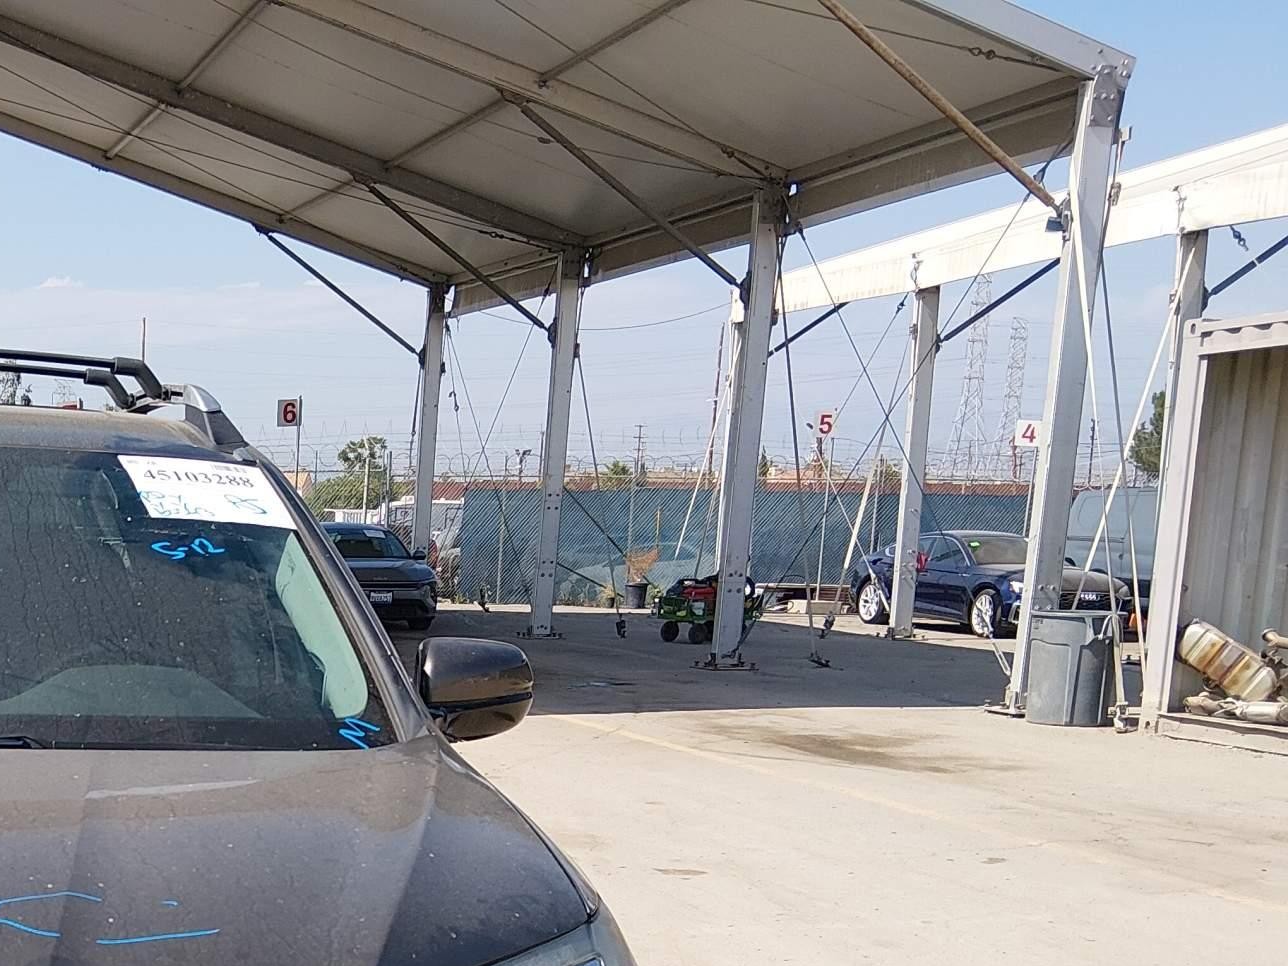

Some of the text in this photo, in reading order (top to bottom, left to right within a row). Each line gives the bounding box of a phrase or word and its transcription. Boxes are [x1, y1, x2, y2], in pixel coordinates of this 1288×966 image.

[283, 402, 297, 424] 6
[818, 414, 833, 434] 5
[1021, 424, 1036, 443] 4
[143, 469, 255, 489] 45103288
